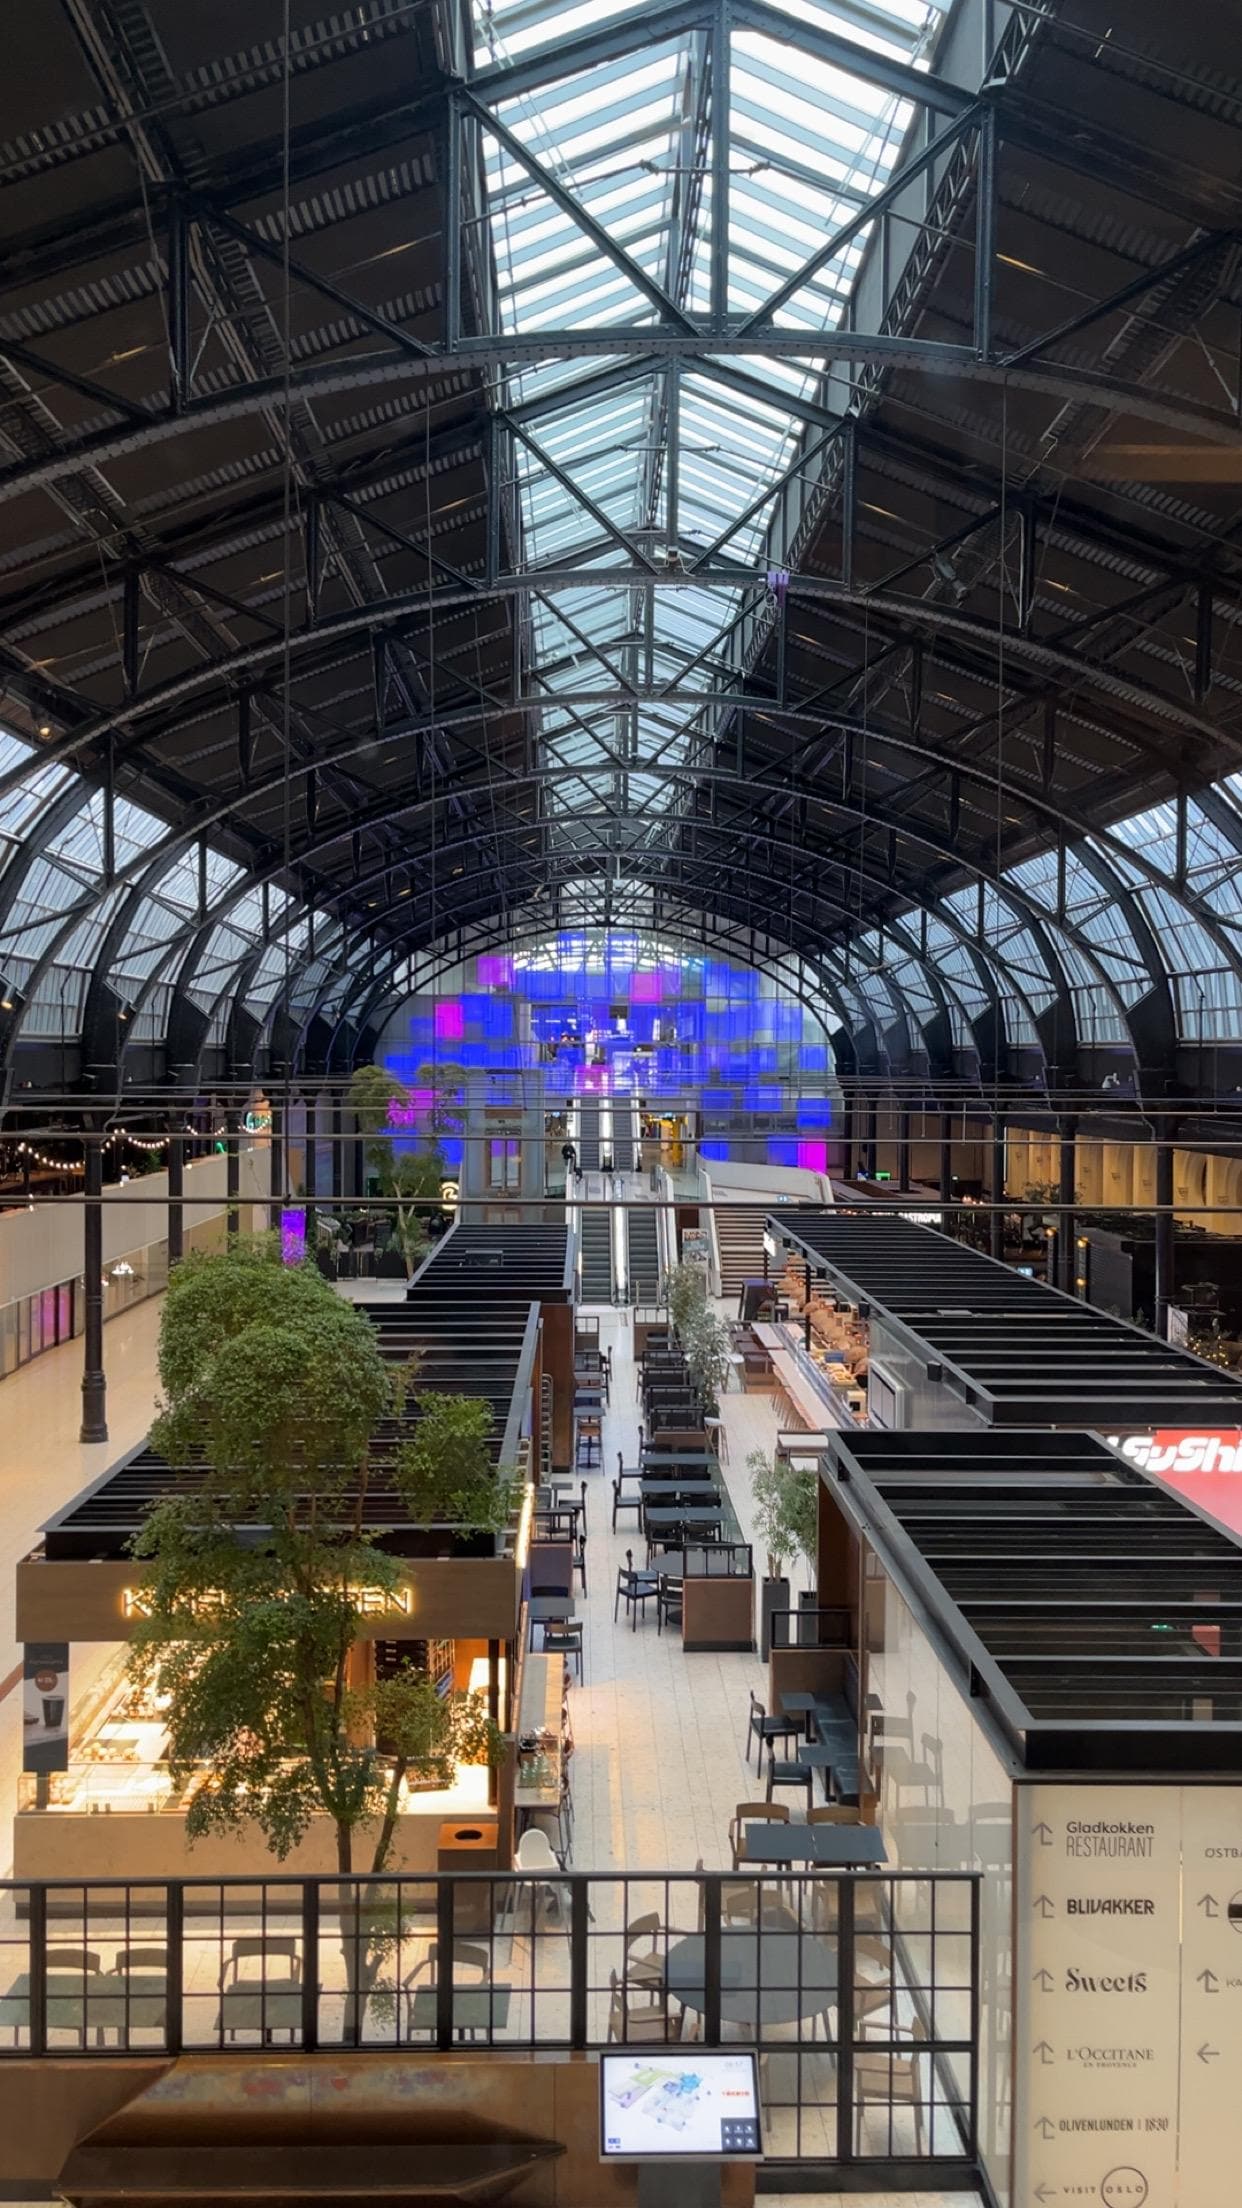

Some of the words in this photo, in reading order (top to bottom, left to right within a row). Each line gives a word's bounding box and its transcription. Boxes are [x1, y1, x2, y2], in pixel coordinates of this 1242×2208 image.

[1066, 1821, 1155, 1834] Gladkokken
[1066, 1836, 1154, 1858] RESTAURANT
[1067, 1899, 1155, 1915] BLIVAKKER
[1065, 1967, 1148, 1993] Sweets
[1059, 2119, 1134, 2131] OLIVENLUNDEN
[1063, 2186, 1096, 2194] VISIT
[1106, 2185, 1144, 2194] OSLO
